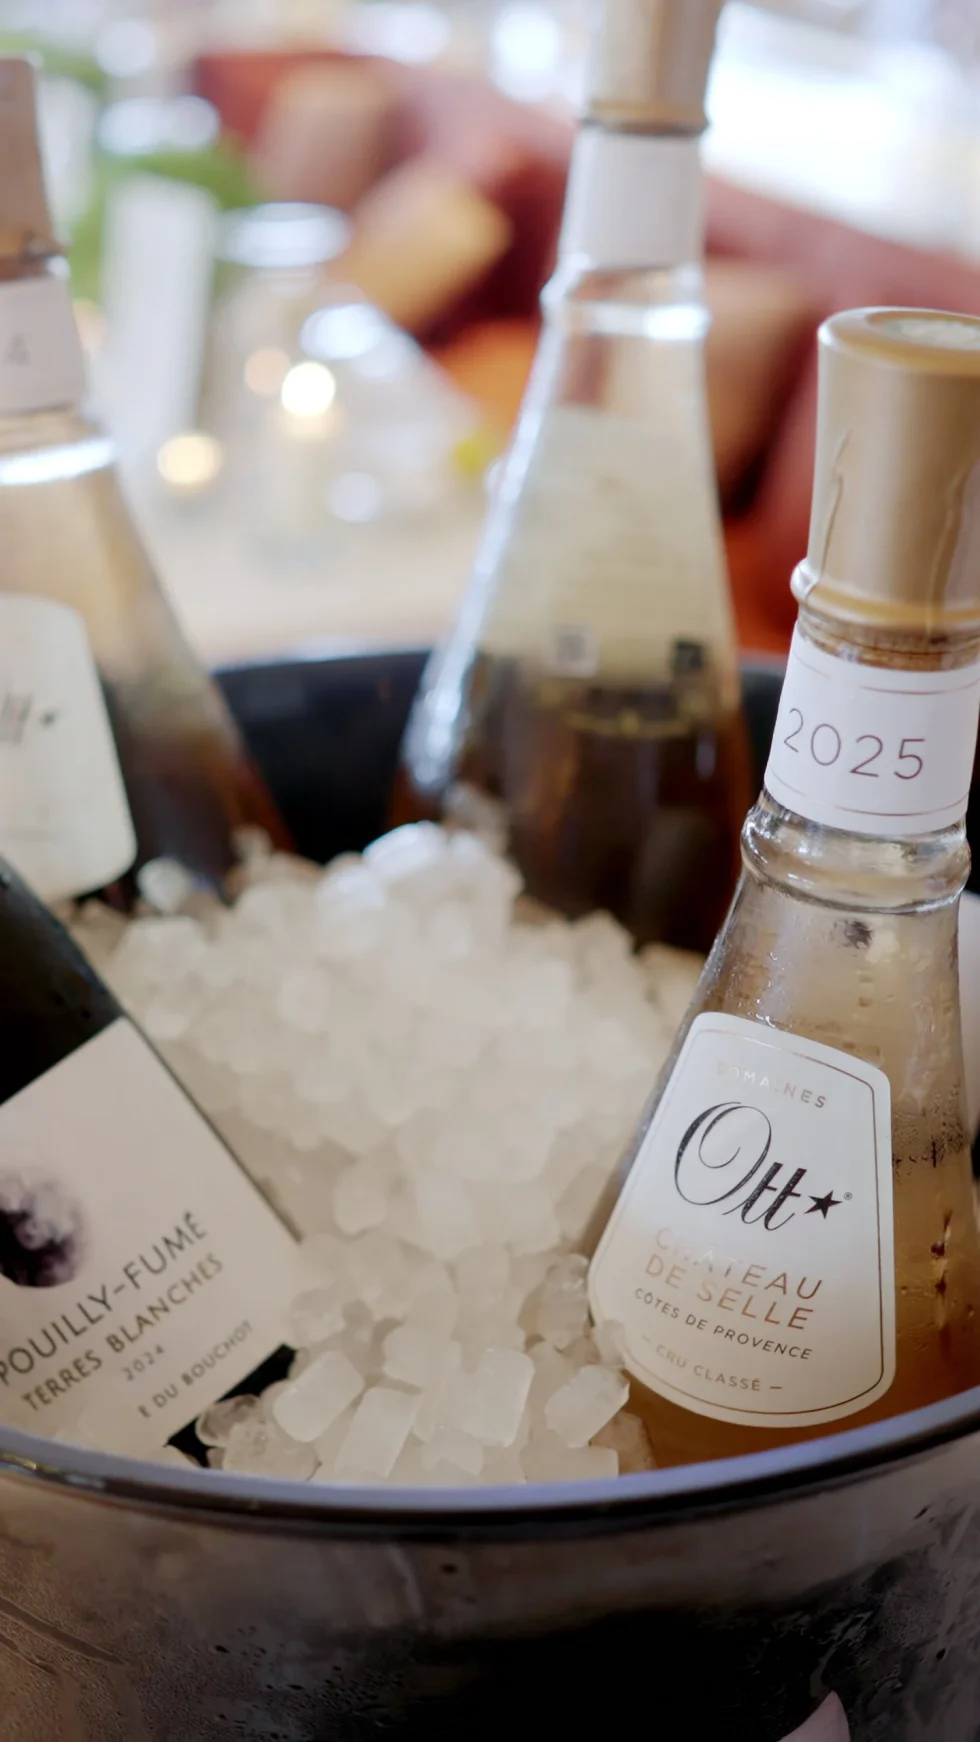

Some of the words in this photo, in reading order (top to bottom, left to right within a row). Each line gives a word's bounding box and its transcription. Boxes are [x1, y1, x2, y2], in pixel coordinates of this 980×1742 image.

[784, 707, 925, 780] 2025
[674, 1101, 807, 1232] Ott
[645, 1253, 688, 1290] DE
[696, 1279, 815, 1331] SELLE
[655, 1227, 823, 1300] CÂTEAU
[21, 1348, 103, 1413] TERRES
[105, 1252, 223, 1354] BLANCHES
[634, 1287, 681, 1320] CÔTES
[685, 1313, 709, 1331] DE
[713, 1324, 813, 1361] PROVENCE
[151, 1383, 180, 1409] DU
[655, 1344, 687, 1369] CRU
[693, 1364, 761, 1392] CLASSÉ
